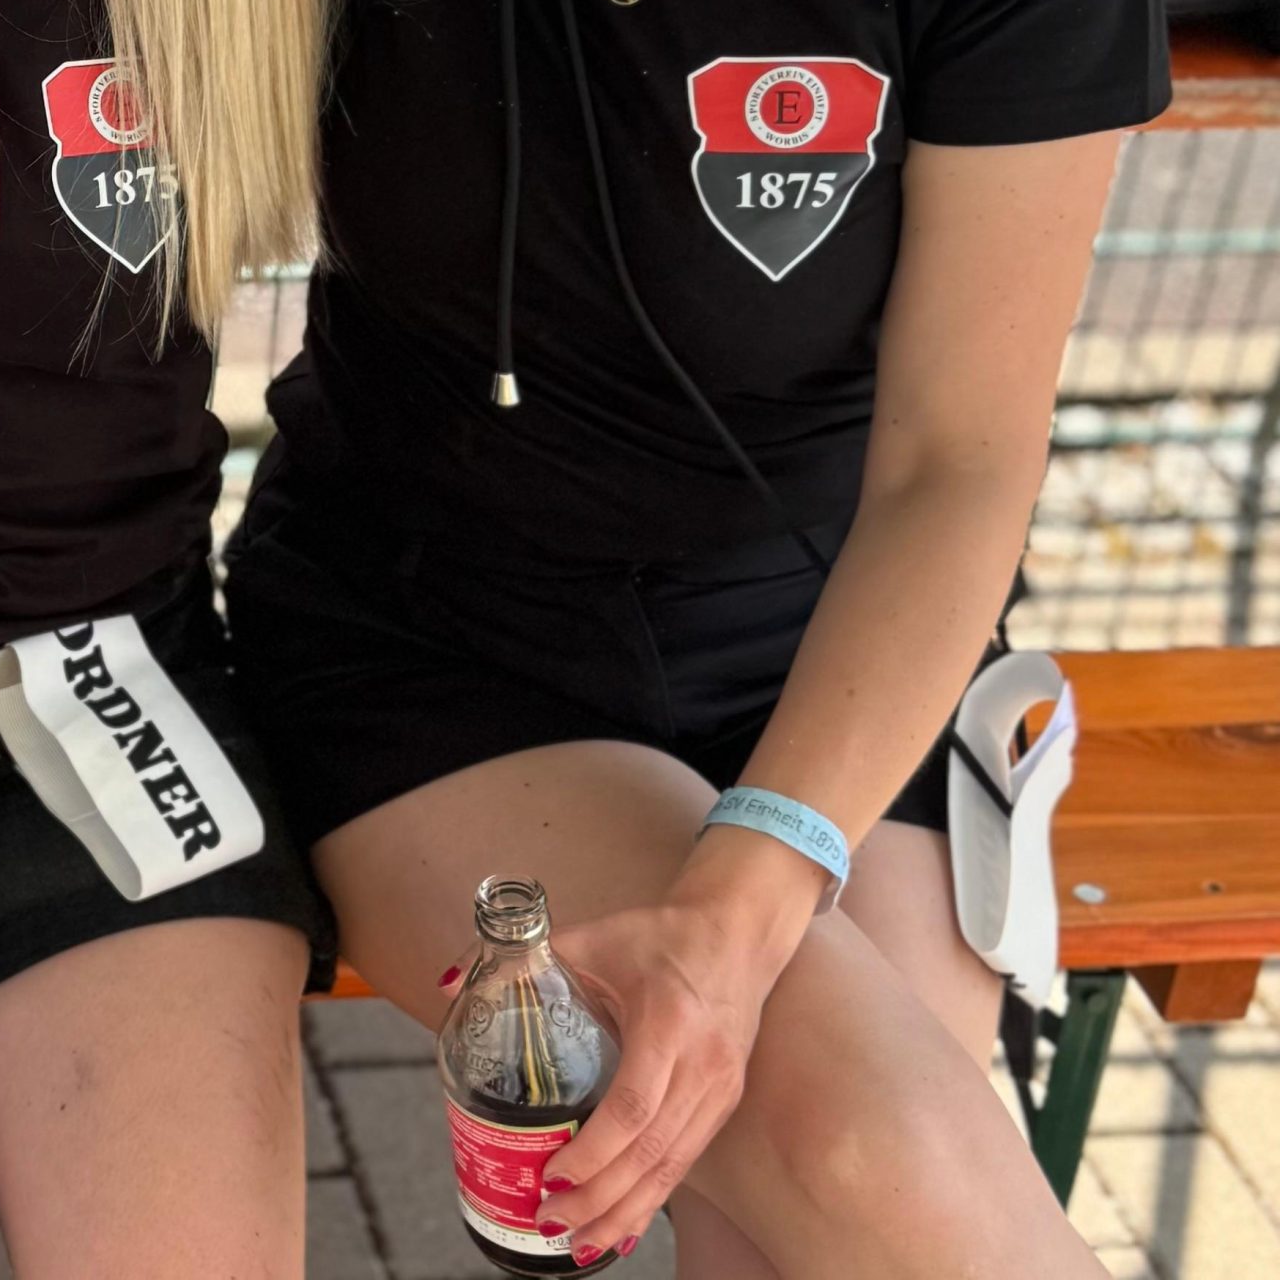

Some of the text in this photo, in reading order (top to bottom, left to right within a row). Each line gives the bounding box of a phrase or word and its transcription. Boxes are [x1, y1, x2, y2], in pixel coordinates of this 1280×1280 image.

[749, 70, 806, 122] SPORTVEREIN
[774, 90, 802, 124] E
[766, 132, 809, 146] WORBIS
[735, 171, 838, 209] 1875
[745, 798, 804, 833] Einheit
[807, 825, 841, 860] 1875
